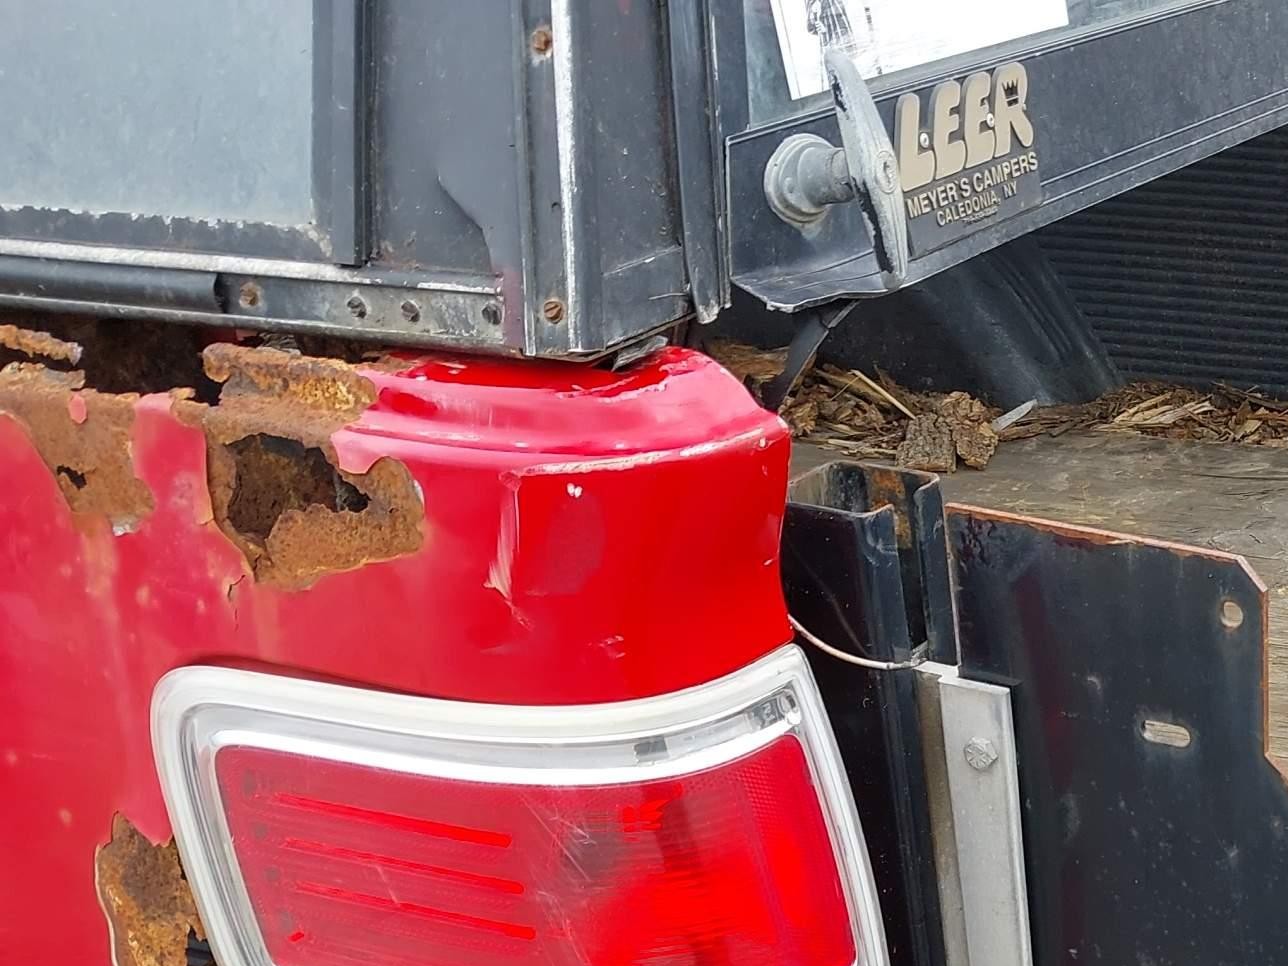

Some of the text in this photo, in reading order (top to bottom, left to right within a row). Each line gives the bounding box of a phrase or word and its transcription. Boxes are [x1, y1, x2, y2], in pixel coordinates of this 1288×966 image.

[895, 61, 1034, 193] LEER
[973, 151, 1038, 194] CAMPERS
[1003, 180, 1018, 199] NY
